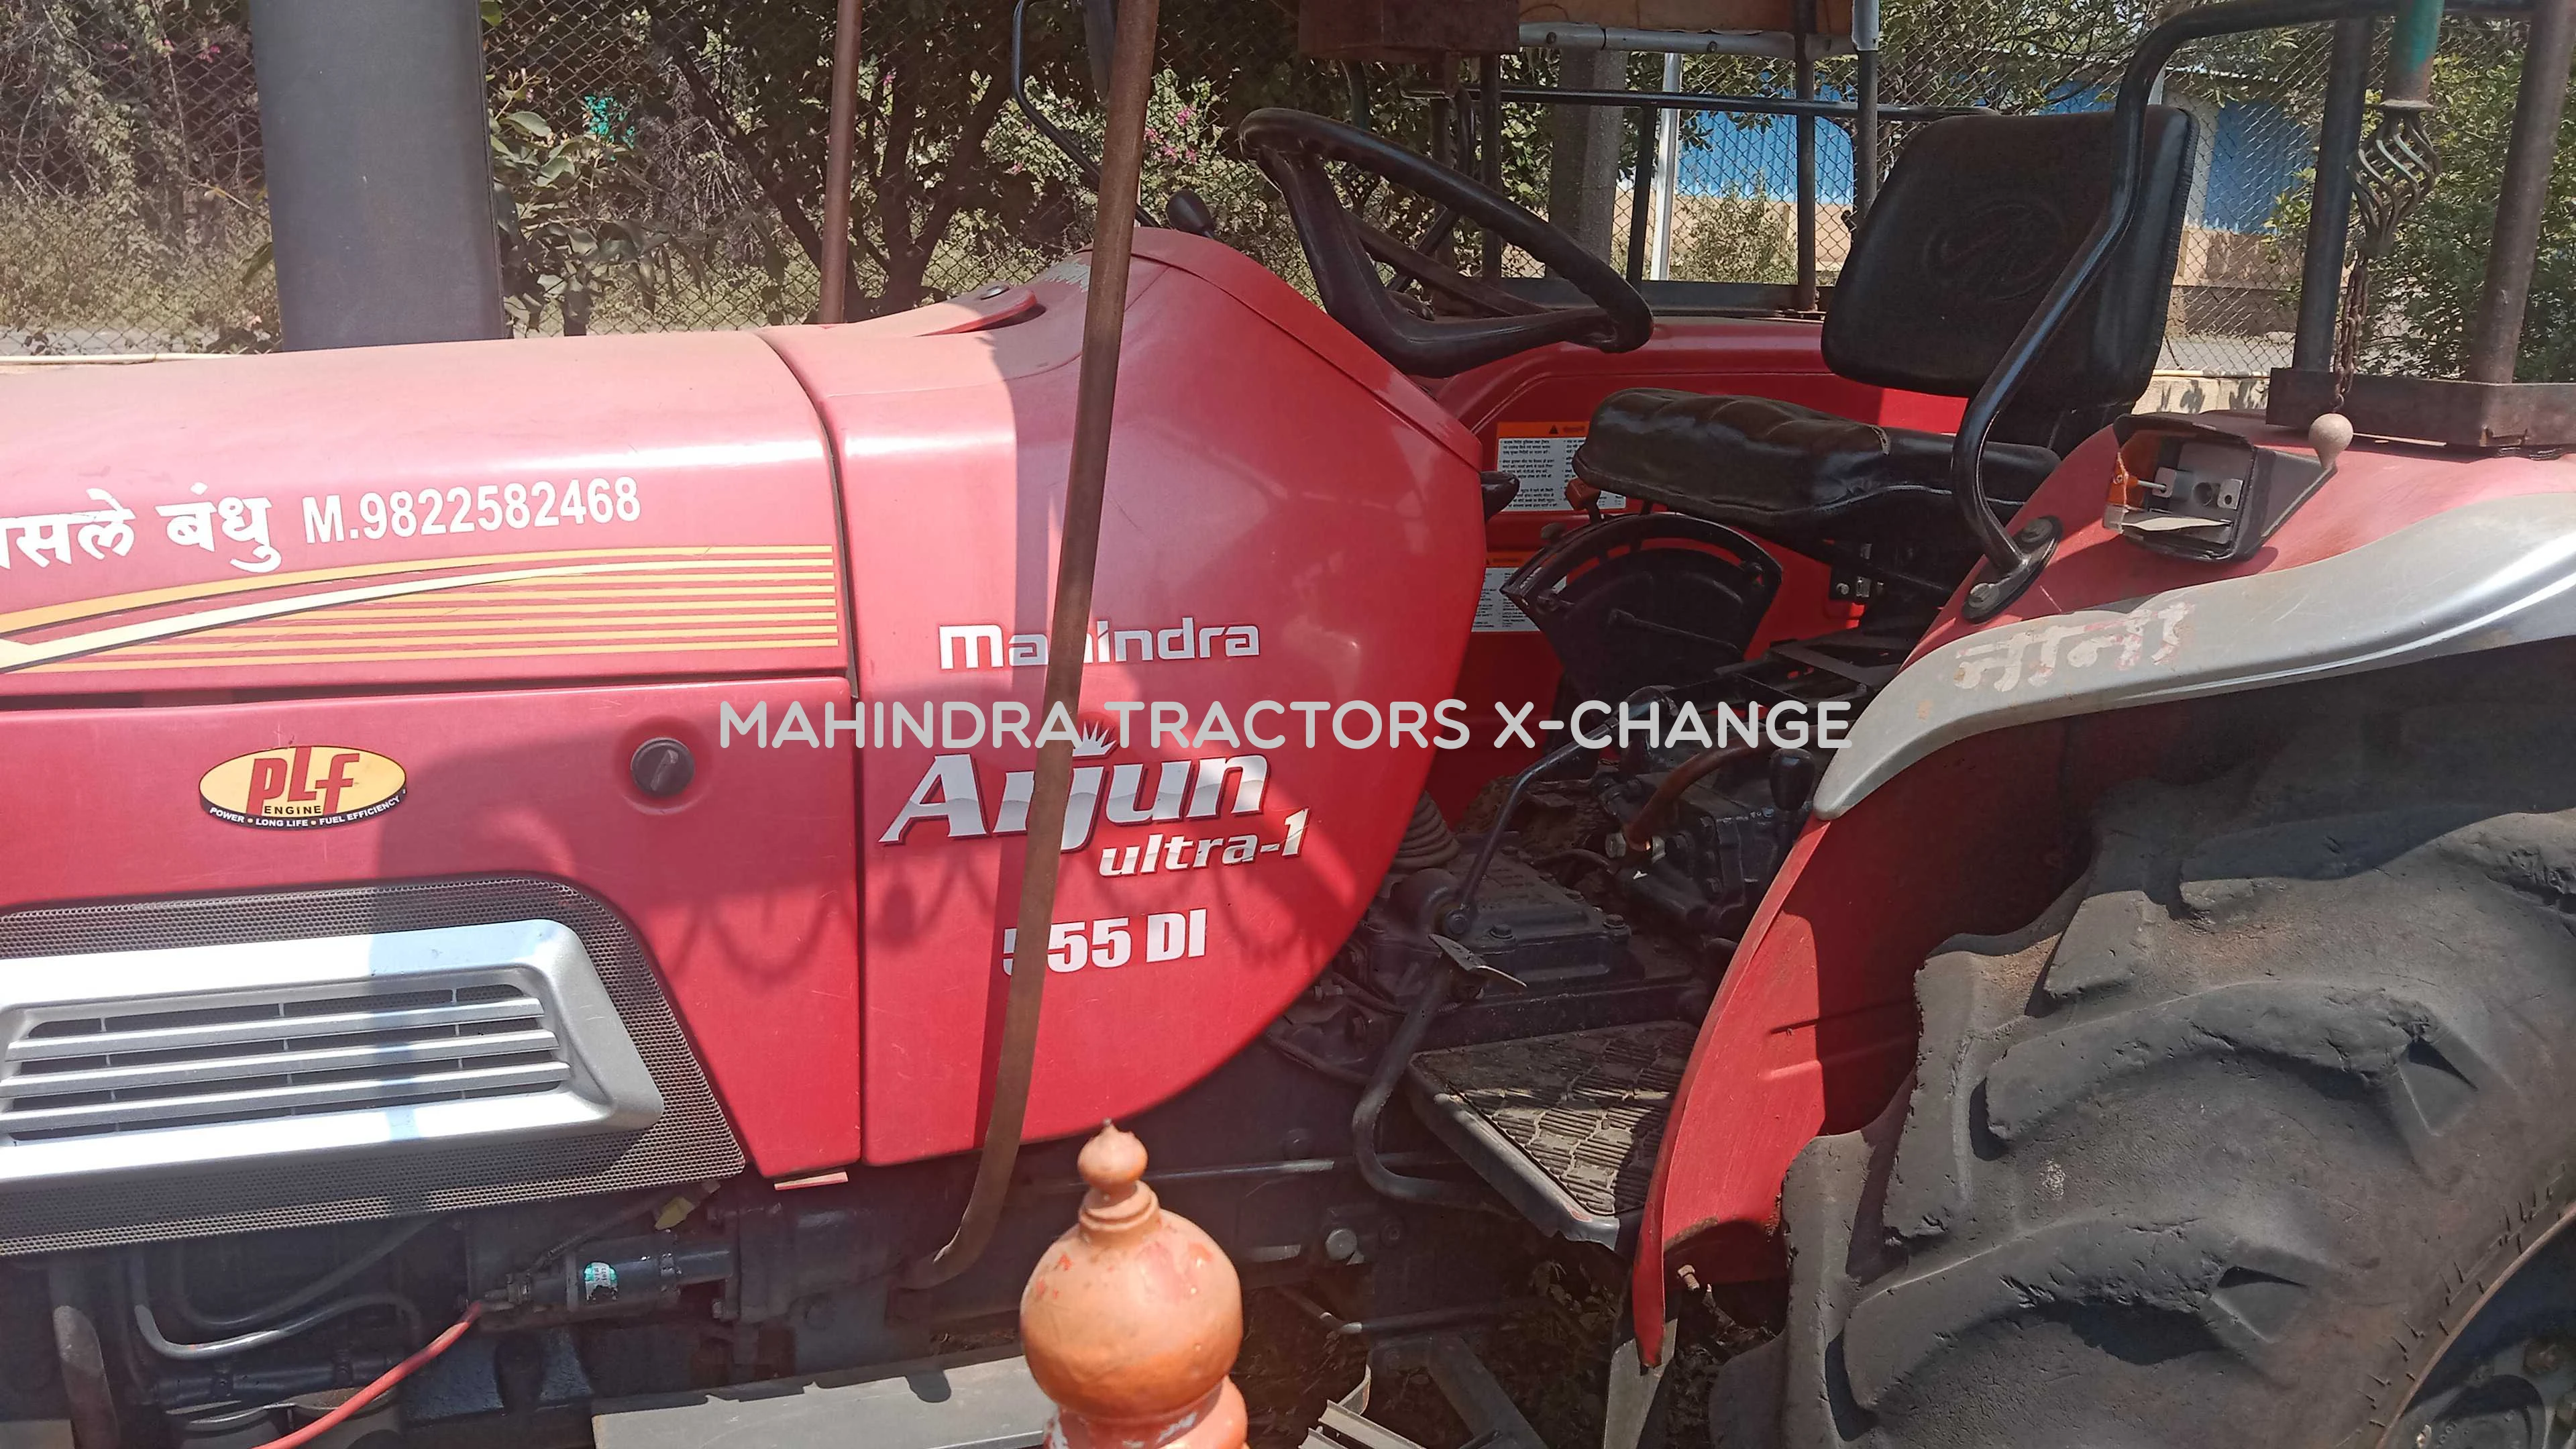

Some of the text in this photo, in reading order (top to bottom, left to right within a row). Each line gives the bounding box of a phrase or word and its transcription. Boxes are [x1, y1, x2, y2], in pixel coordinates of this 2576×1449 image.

[154, 482, 282, 574] बंधु
[302, 476, 641, 544] M.9822582468
[938, 617, 1260, 669] Maindra
[209, 796, 401, 827] POWER LONG LIFE FUEL EFFICIENCY
[264, 804, 322, 815] ENGINE
[1097, 806, 1311, 877] ultra-1
[1146, 908, 1208, 963] DI
